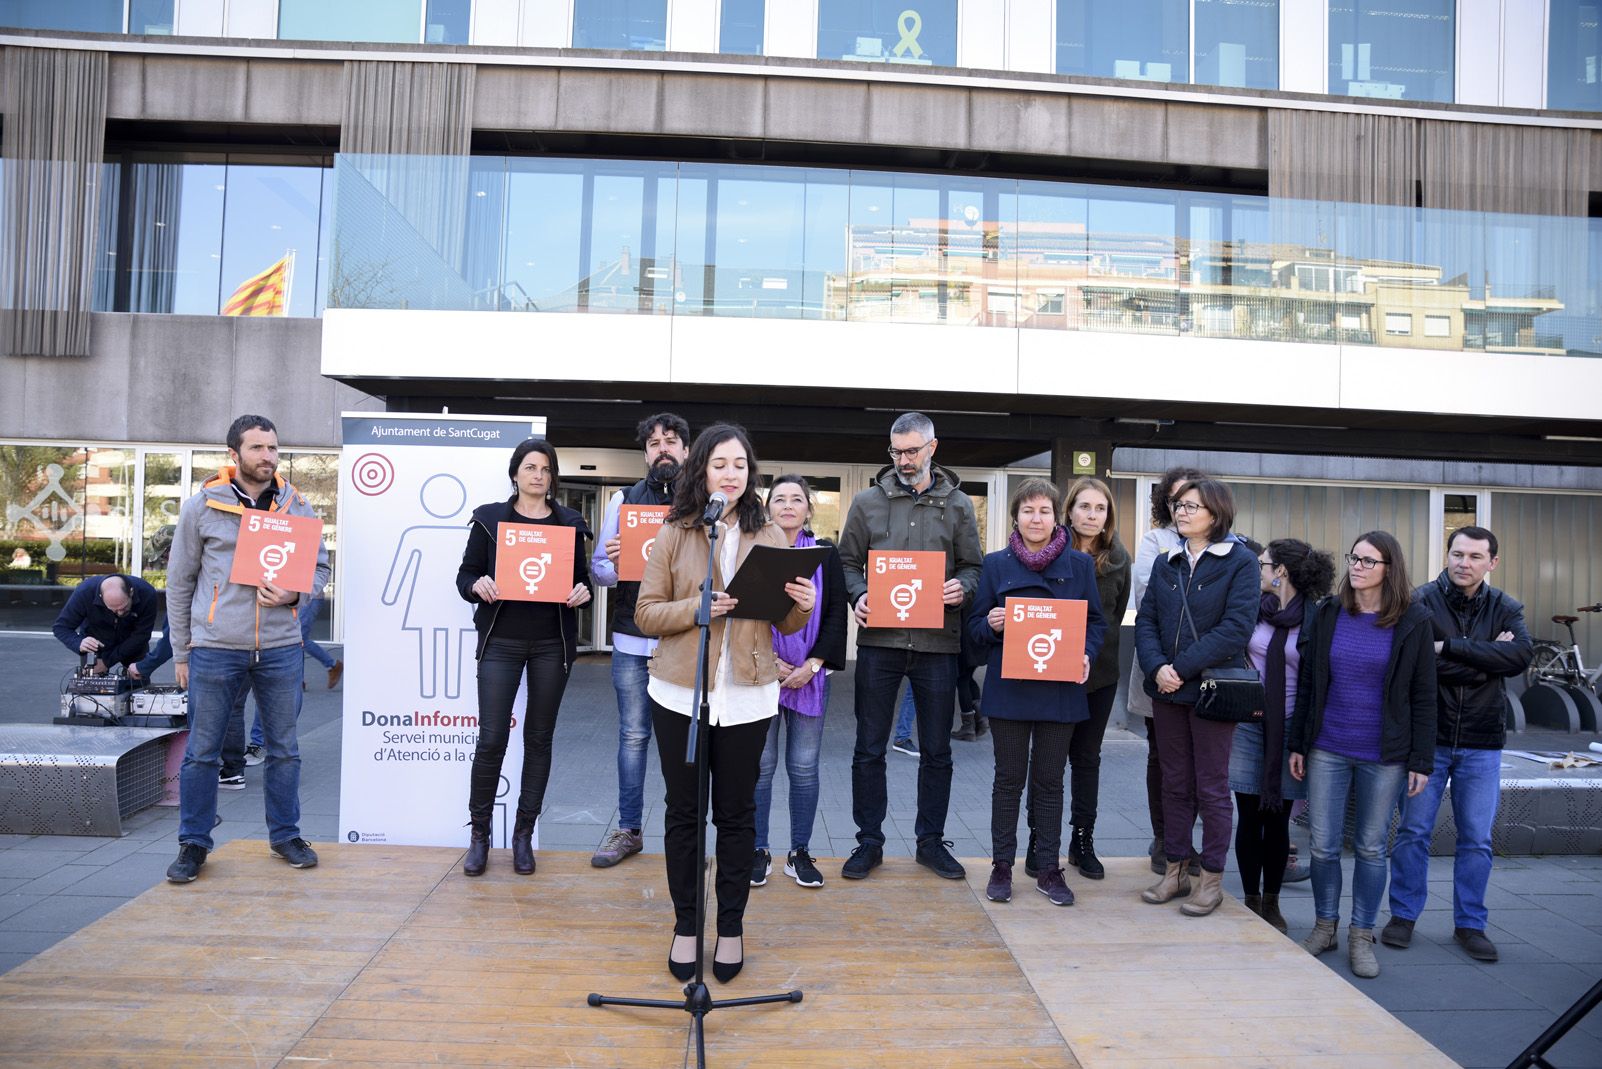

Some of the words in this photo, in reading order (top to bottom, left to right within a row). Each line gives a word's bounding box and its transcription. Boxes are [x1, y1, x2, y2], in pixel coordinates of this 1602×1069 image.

[371, 426, 430, 438] Ajuntament
[433, 427, 446, 437] de
[448, 427, 500, 440] SantCugat
[248, 515, 261, 532] 5
[627, 511, 638, 528] 5
[505, 529, 516, 546] 5
[876, 557, 886, 574] 5
[1013, 604, 1024, 622] 5
[362, 711, 517, 729] DonaInformó
[383, 731, 425, 744] Servei
[428, 732, 480, 744] munici
[374, 748, 440, 761] d'Atenció
[444, 753, 450, 762] a
[455, 748, 466, 762] la
